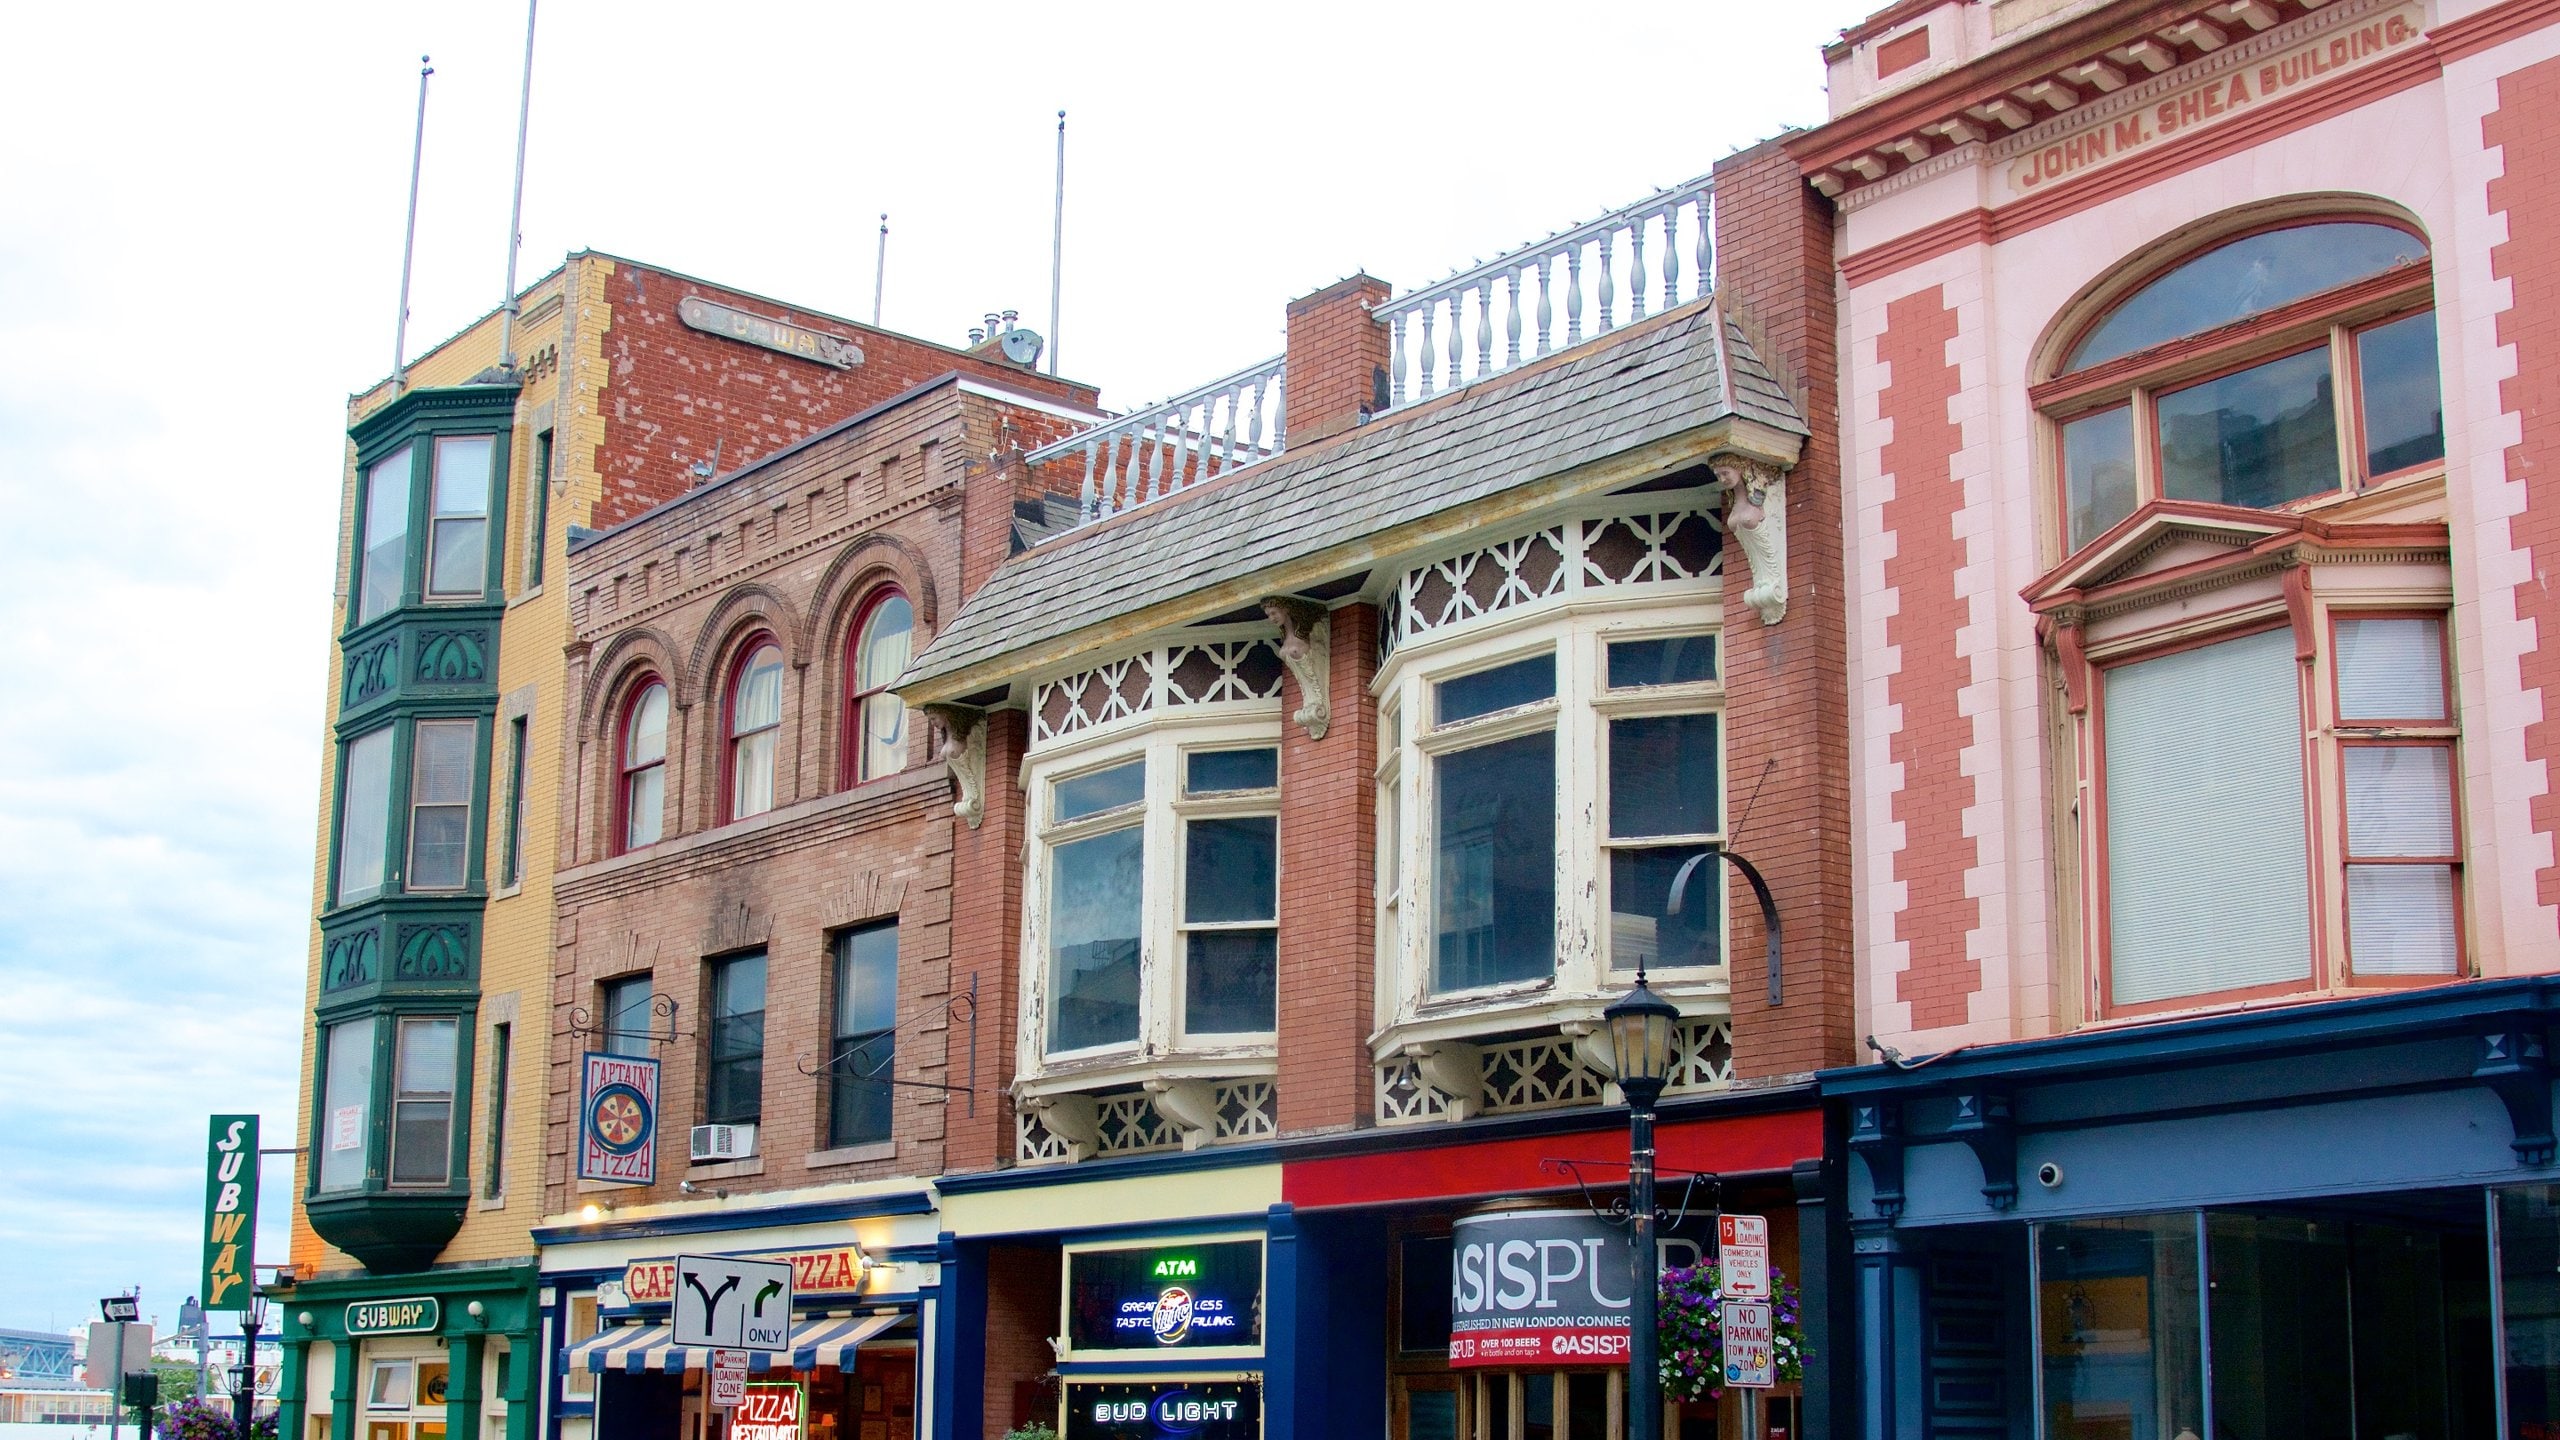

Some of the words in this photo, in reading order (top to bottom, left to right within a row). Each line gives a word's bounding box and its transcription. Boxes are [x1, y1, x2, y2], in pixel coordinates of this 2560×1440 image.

[2022, 128, 2107, 188] JOHN
[2114, 115, 2151, 154] M.
[2157, 73, 2253, 135] SHEA
[2260, 14, 2418, 97] BUILDING.
[590, 1060, 654, 1106] CAPTAIN'S
[587, 1134, 650, 1178] PIZZA
[209, 1120, 247, 1305] SUBWAY
[1722, 1221, 1733, 1237] 15
[1743, 1220, 1755, 1231] MIN
[1736, 1233, 1764, 1244] LOADING
[1724, 1248, 1763, 1258] COMMERCIAL
[1155, 1260, 1196, 1276] ATM
[1729, 1259, 1759, 1268] VEHICLES
[631, 1265, 675, 1299] CAP
[775, 1252, 855, 1290] IZZA
[1736, 1270, 1752, 1278] ONLY
[112, 1304, 123, 1315] ONE
[124, 1304, 134, 1314] WAY
[1121, 1301, 1157, 1312] GREAT
[1194, 1300, 1223, 1311] LESS
[357, 1304, 423, 1329] SUBWAY
[1116, 1317, 1153, 1328] TASTE
[1492, 1318, 1501, 1329] IN
[1502, 1317, 1525, 1328] NEW
[1526, 1316, 1574, 1328] LONDON
[1577, 1315, 1631, 1327] CONNEC
[1738, 1308, 1756, 1324] NO
[748, 1327, 781, 1344] ONLY
[1728, 1325, 1768, 1343] PARKING
[1481, 1340, 1499, 1348] OVER
[1501, 1339, 1513, 1348] 100
[1515, 1338, 1541, 1347] BEERS
[1504, 1348, 1515, 1356] and
[1525, 1349, 1535, 1358] tap
[1728, 1344, 1744, 1356] TOW
[1747, 1346, 1768, 1357] AWAY
[715, 1352, 725, 1364] NO
[725, 1355, 746, 1364] PARKING
[716, 1370, 744, 1382] LOADING
[717, 1382, 742, 1394] ZONE
[738, 1390, 798, 1422] PIZZA
[1095, 1402, 1147, 1422] BUD
[1162, 1400, 1237, 1421] LIGHT
